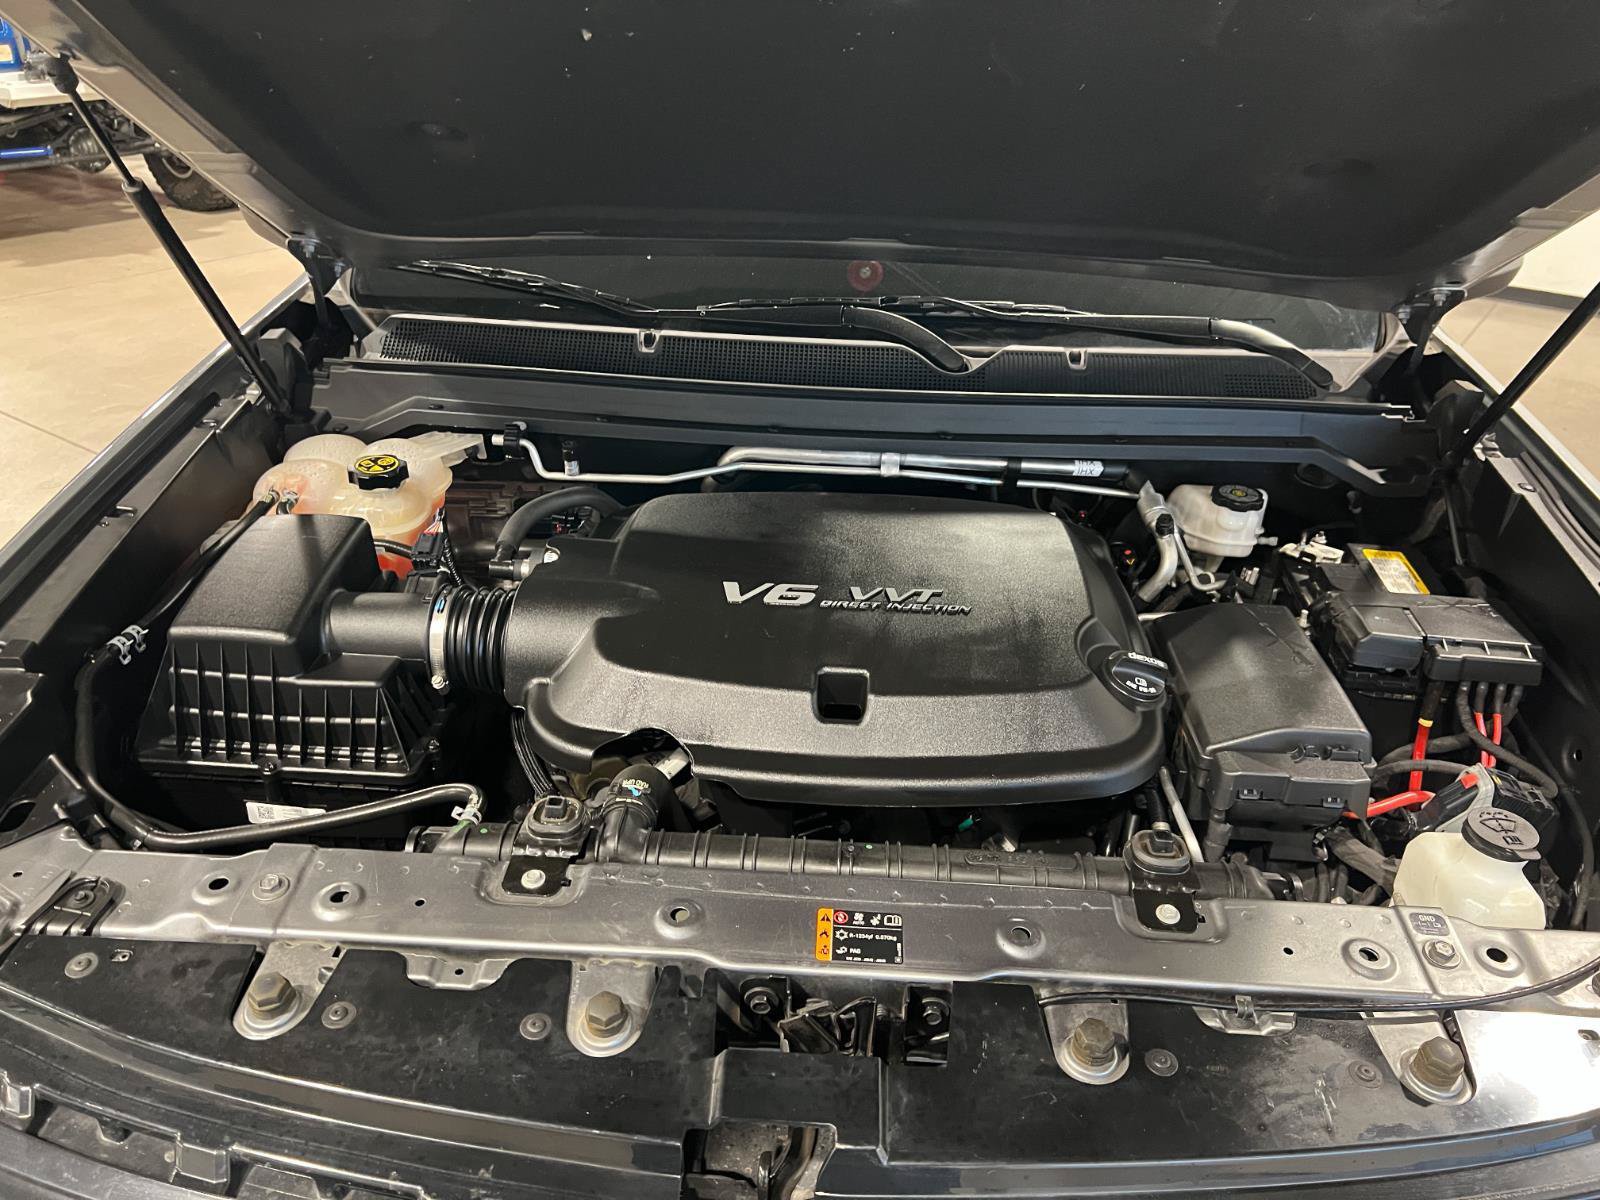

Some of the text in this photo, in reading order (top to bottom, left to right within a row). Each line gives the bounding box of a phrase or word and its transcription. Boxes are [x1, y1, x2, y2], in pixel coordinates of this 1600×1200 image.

[722, 581, 819, 606] V6
[849, 586, 944, 604] VVT
[819, 599, 972, 616] DIRECT INJECTION
[849, 947, 861, 955] PAG
